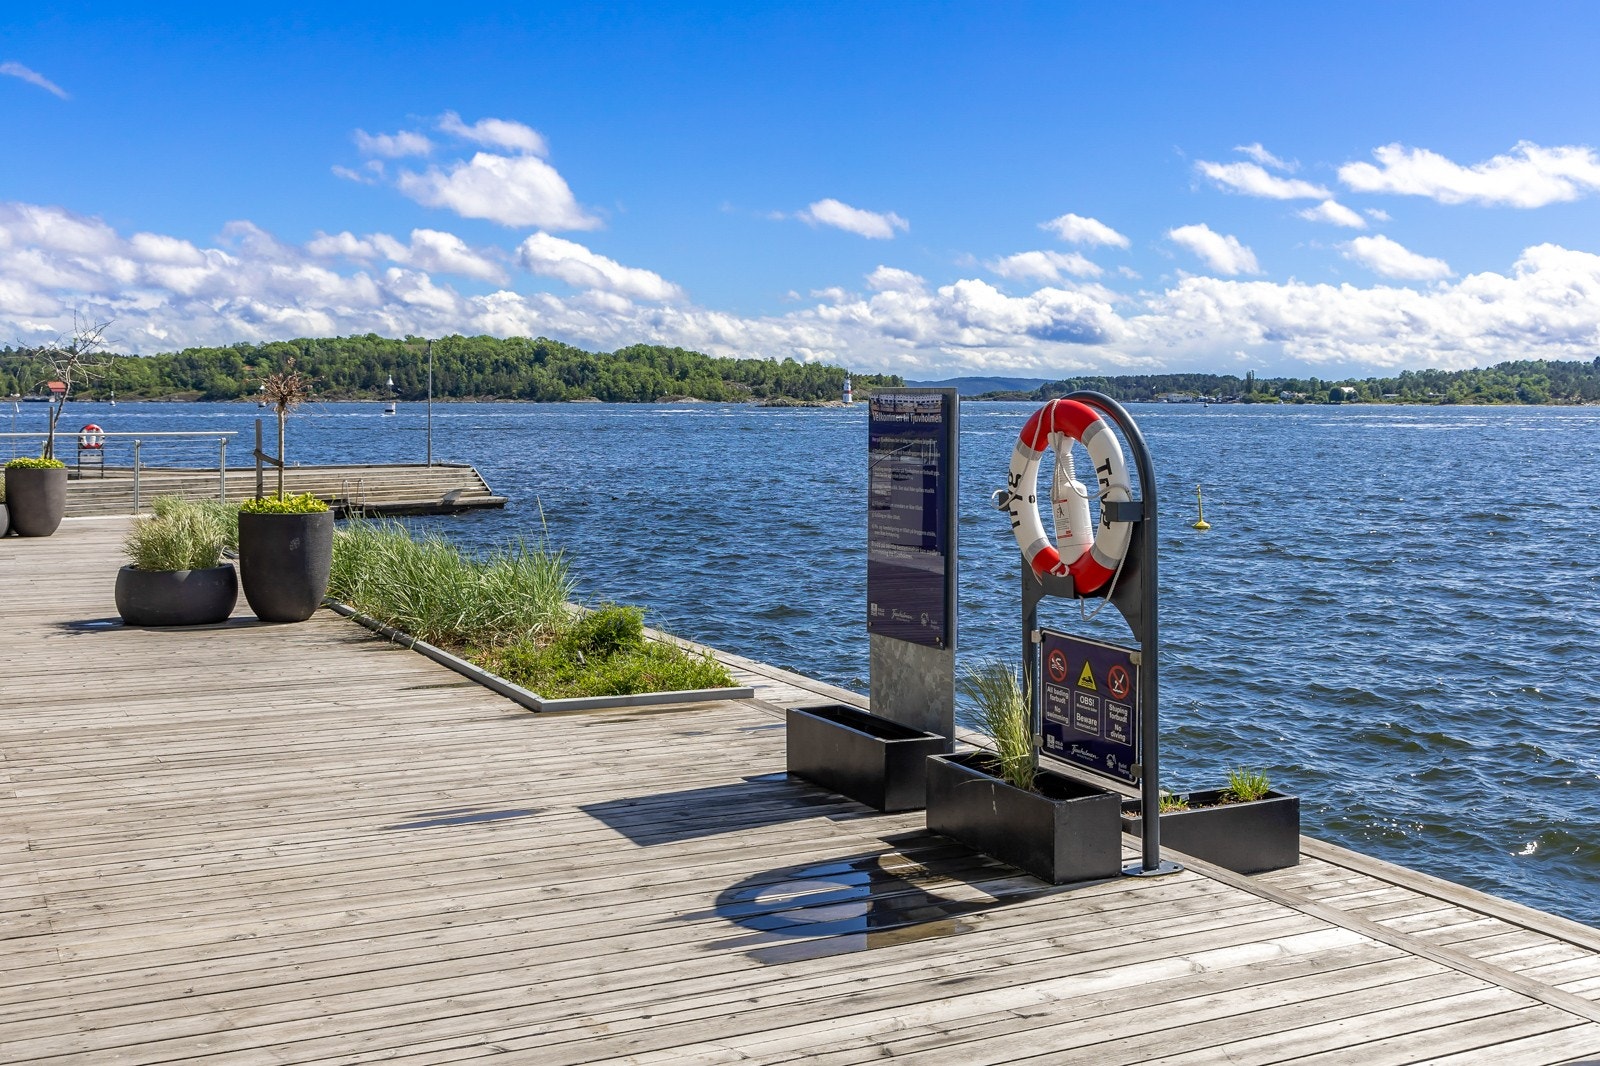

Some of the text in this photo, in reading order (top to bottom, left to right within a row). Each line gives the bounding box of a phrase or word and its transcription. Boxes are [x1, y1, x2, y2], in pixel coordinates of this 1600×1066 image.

[1049, 694, 1066, 704] forbudt
[1080, 696, 1095, 706] OBS!
[1109, 703, 1128, 716] Stuping
[1047, 712, 1069, 724] swimming
[1076, 712, 1097, 726] Beware
[1109, 712, 1128, 723] forbudt
[1114, 724, 1122, 732] No
[1110, 730, 1126, 742] diving
